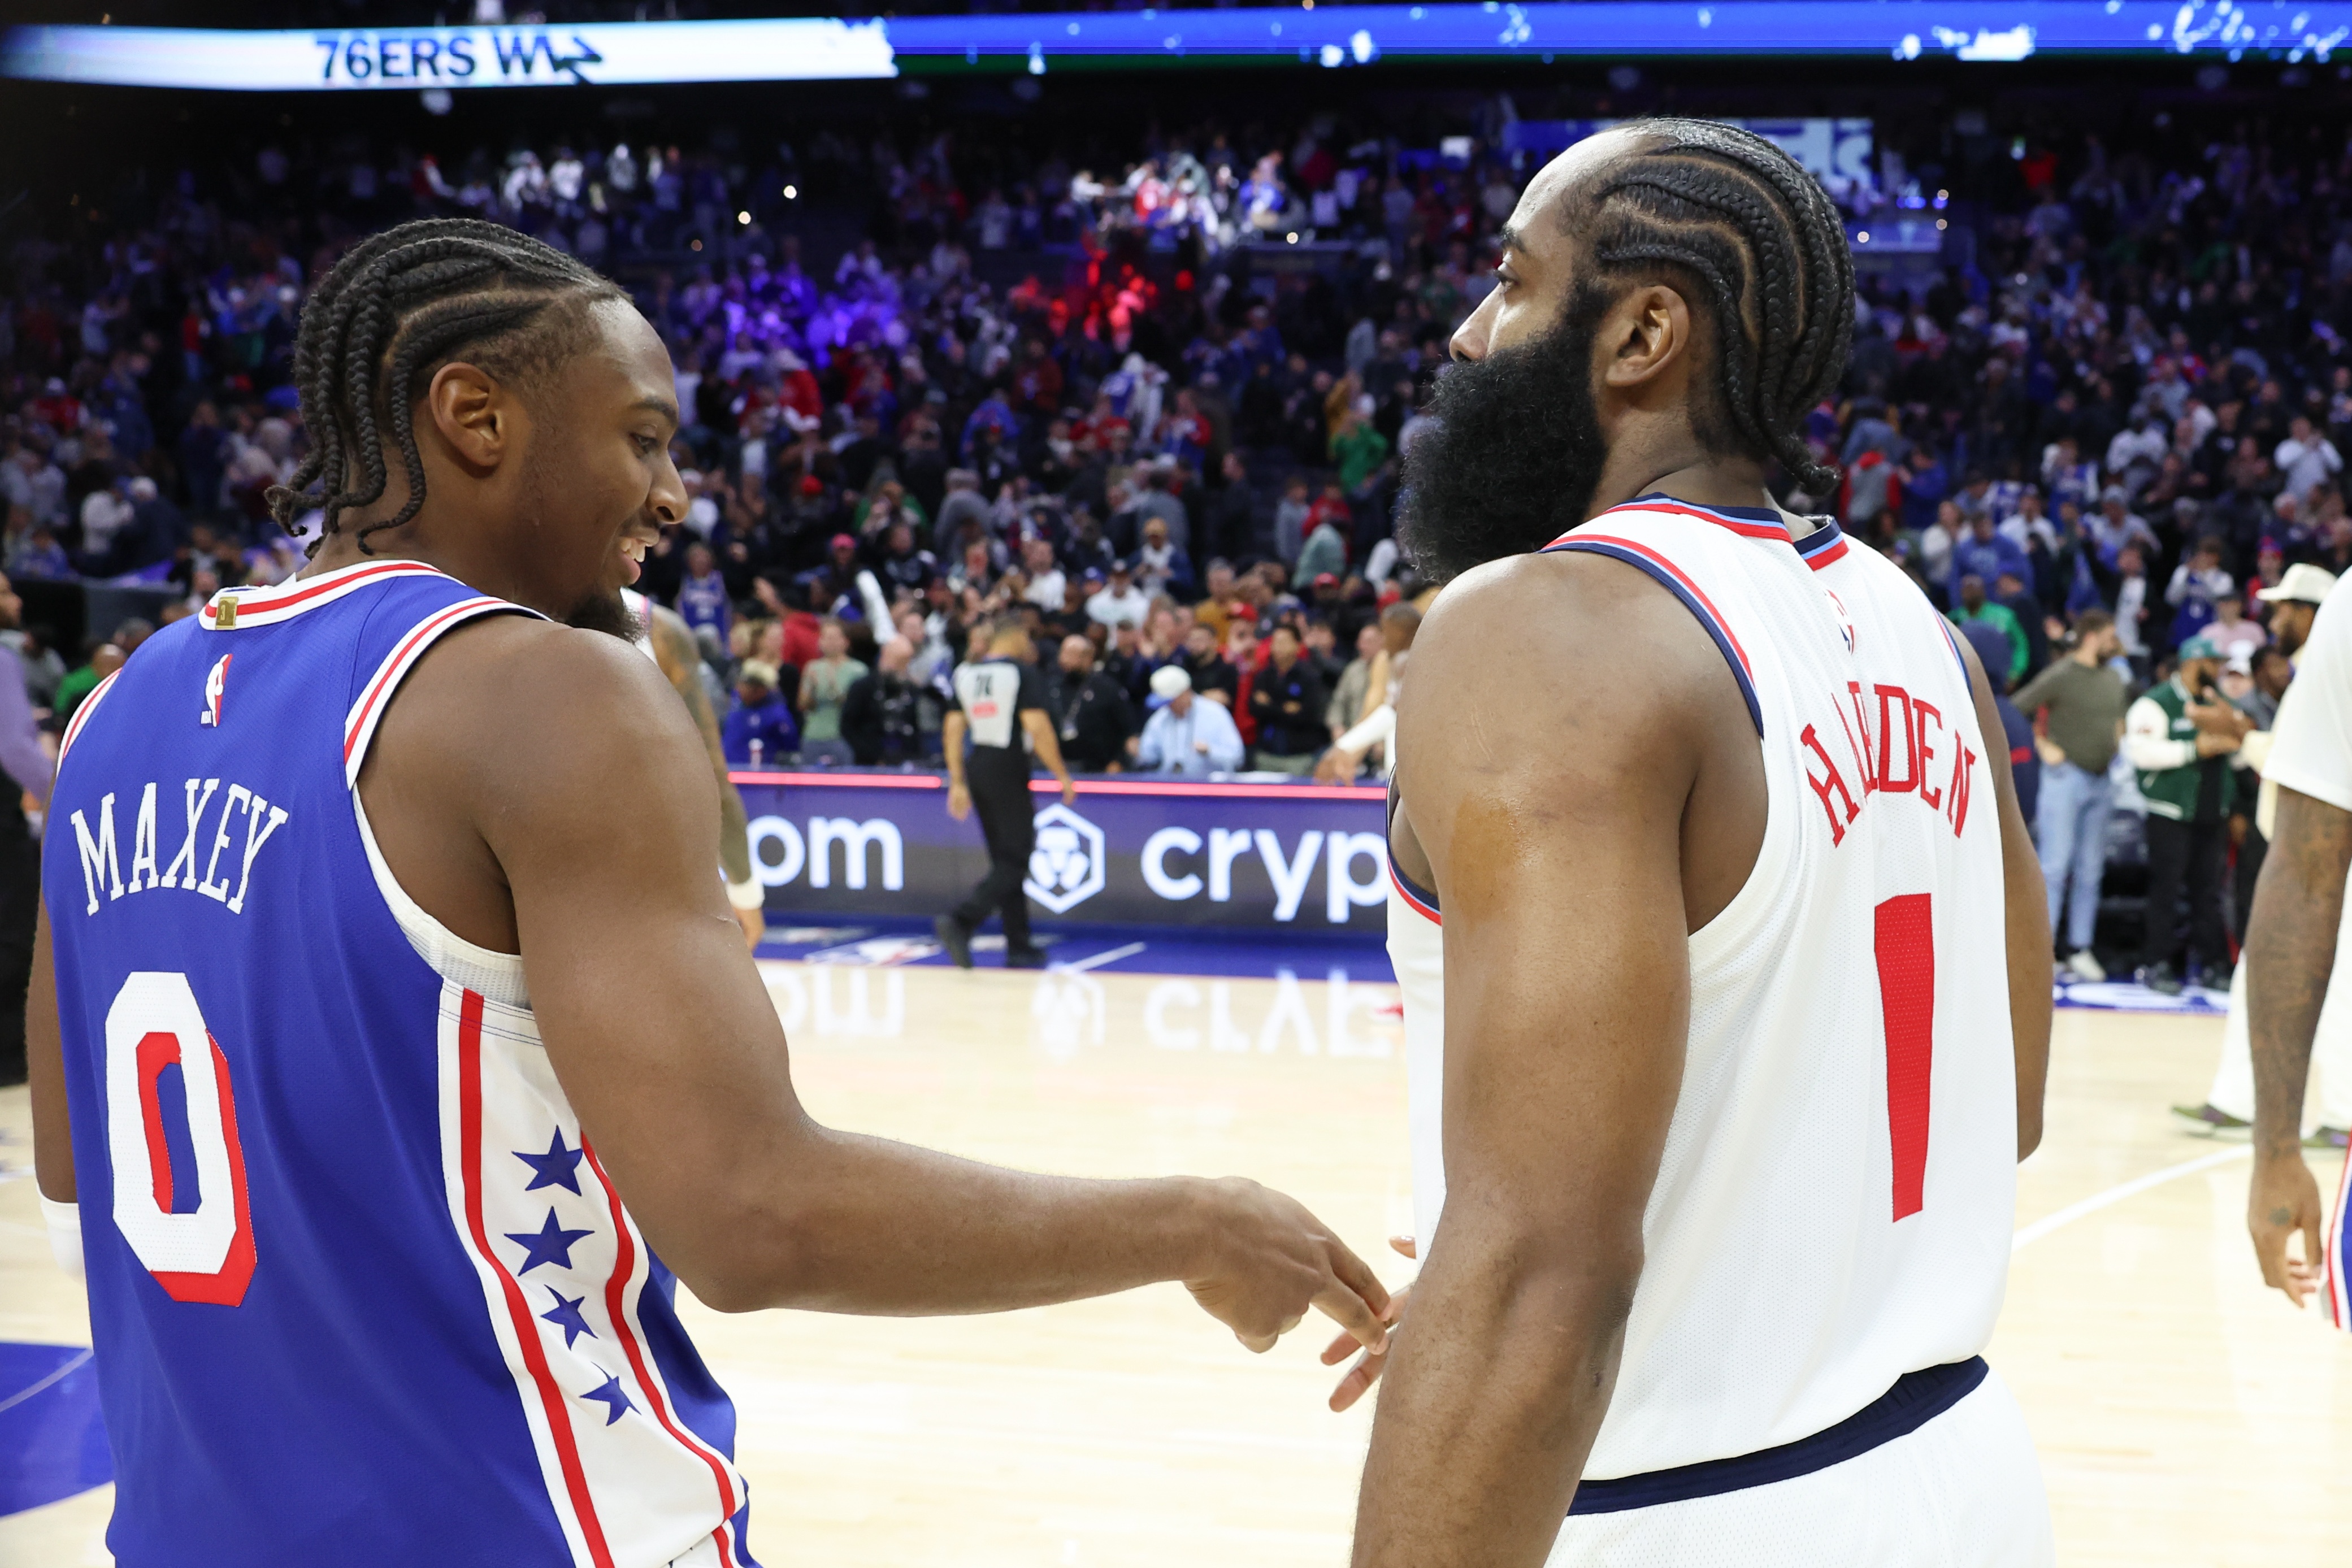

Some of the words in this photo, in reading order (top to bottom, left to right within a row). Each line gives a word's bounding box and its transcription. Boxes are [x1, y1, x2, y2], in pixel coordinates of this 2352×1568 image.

[316, 37, 476, 79] 76ERS
[201, 710, 212, 724] NBA
[1800, 680, 1977, 849] HDEN
[71, 778, 289, 917] MAXEY
[718, 814, 904, 891] om
[1874, 893, 1935, 1223] 1
[105, 971, 258, 1307] 0
